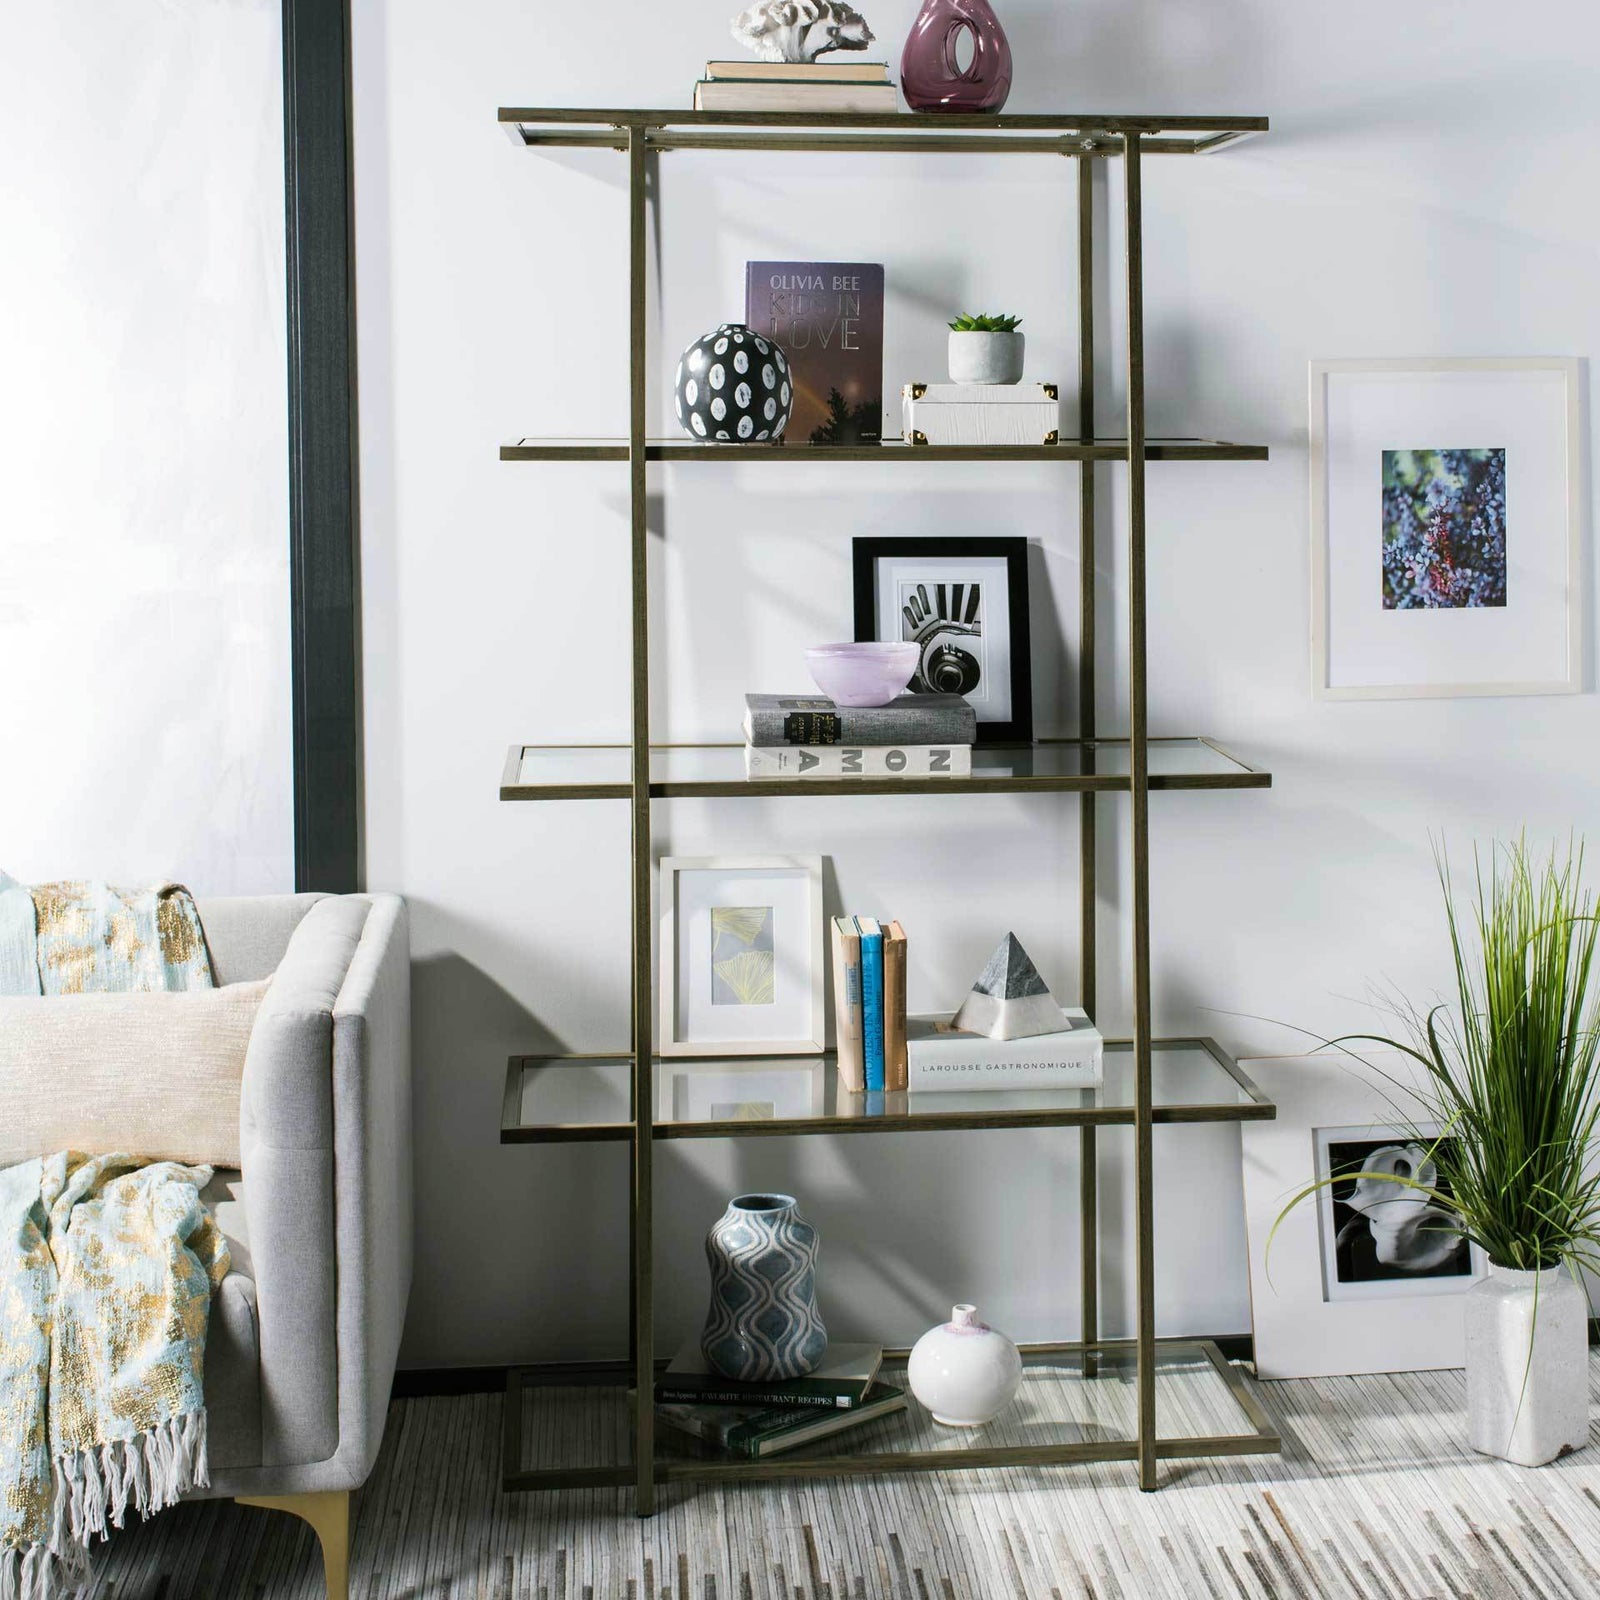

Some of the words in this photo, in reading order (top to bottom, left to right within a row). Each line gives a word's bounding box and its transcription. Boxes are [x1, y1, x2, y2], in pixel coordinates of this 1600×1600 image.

[769, 275, 825, 290] OLIVIA
[832, 276, 861, 291] BEE
[838, 293, 860, 316] IN
[865, 1029, 874, 1080] WOMEN
[922, 1062, 981, 1073] LAROUSSE
[986, 1061, 1083, 1072] GASTRONOMIQUE
[701, 1392, 741, 1401] FAVORITE
[798, 1395, 833, 1406] RECIPES
